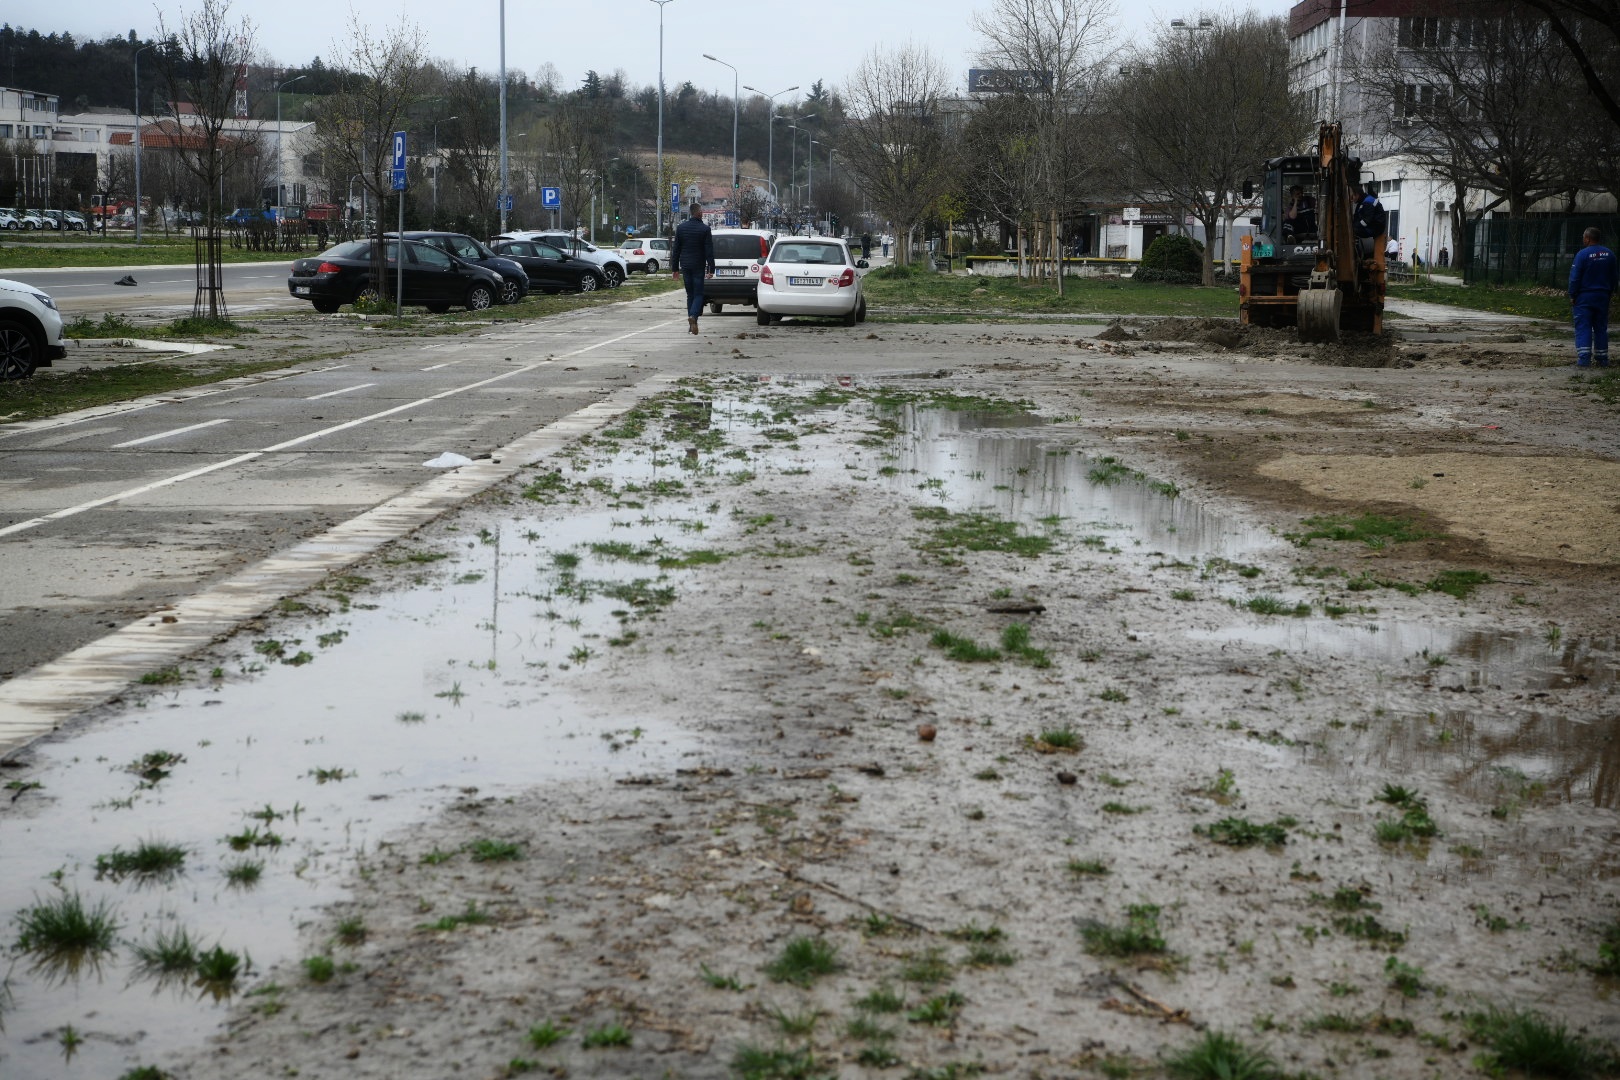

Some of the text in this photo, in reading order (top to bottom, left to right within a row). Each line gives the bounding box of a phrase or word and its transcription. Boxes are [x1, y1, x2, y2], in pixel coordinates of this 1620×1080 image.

[395, 136, 402, 165] P
[545, 189, 556, 204] P
[673, 185, 678, 200] P
[1294, 246, 1318, 255] CAS
